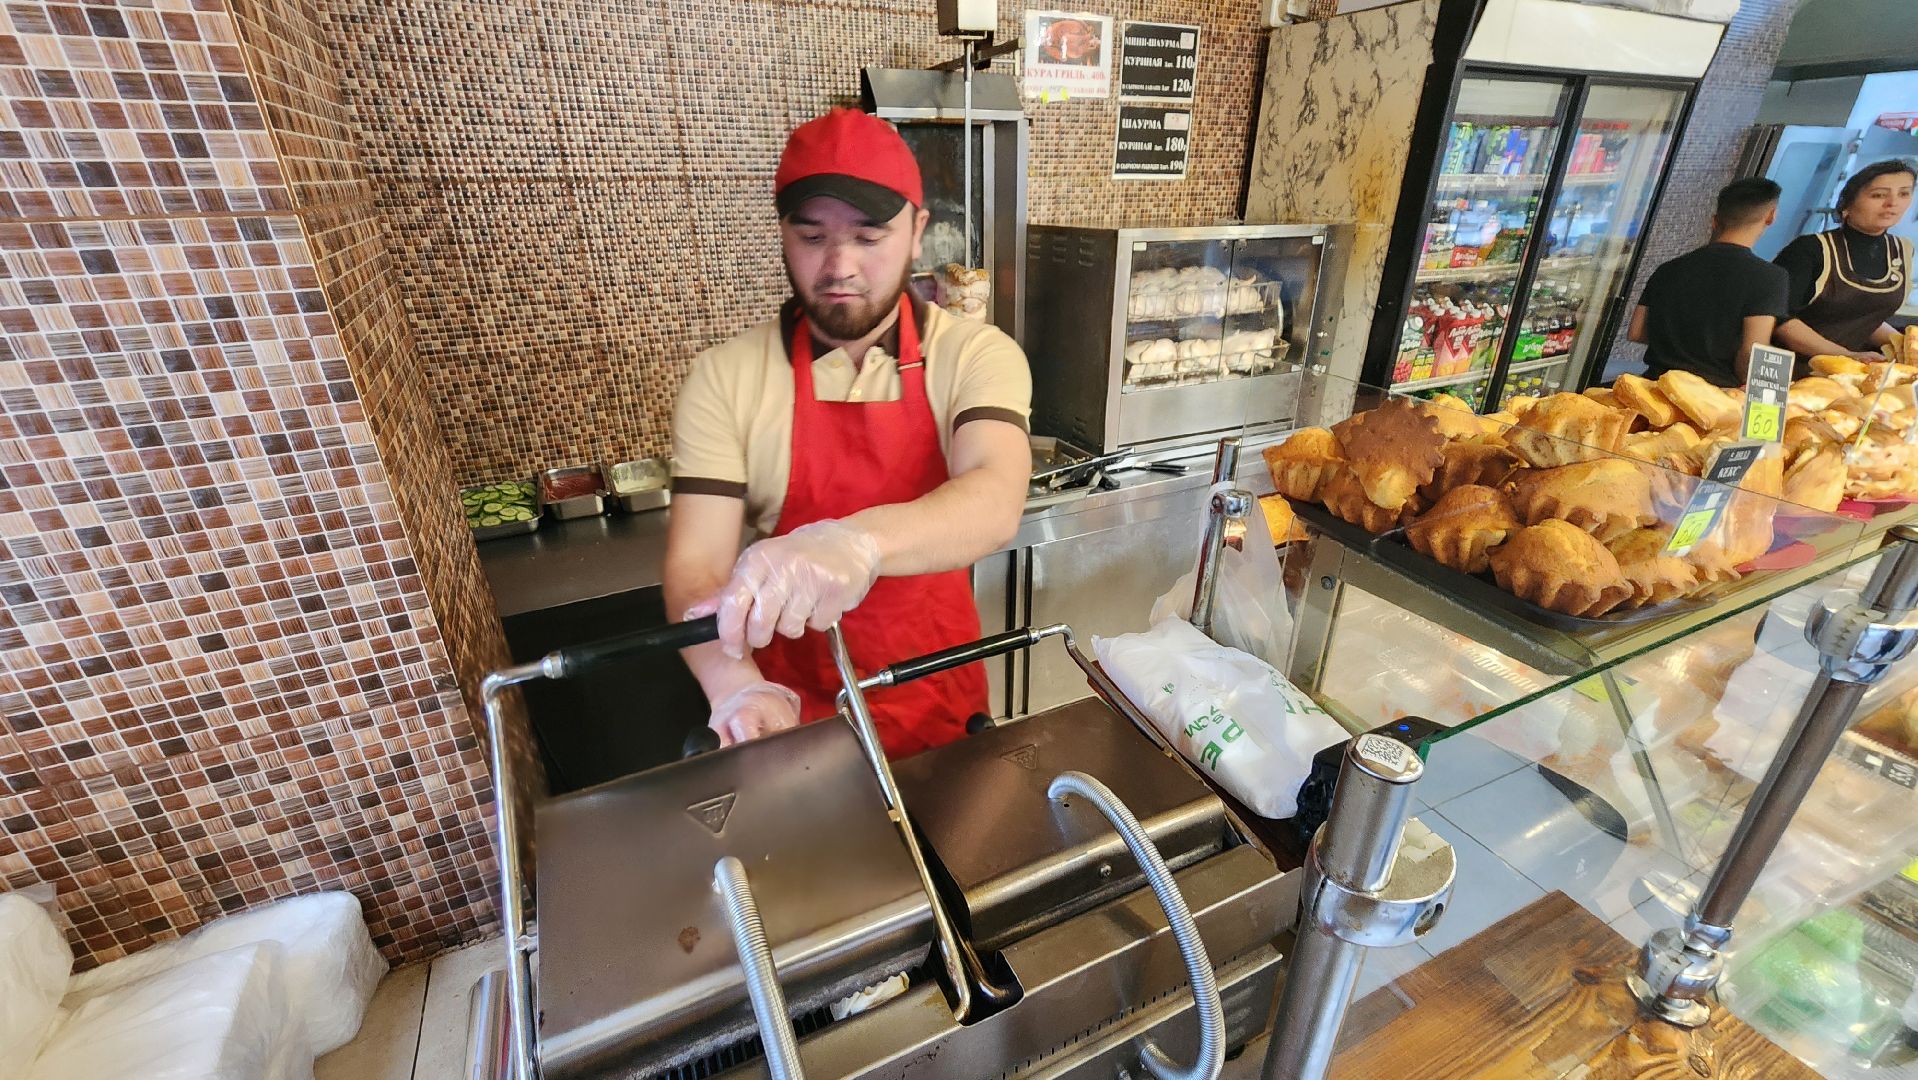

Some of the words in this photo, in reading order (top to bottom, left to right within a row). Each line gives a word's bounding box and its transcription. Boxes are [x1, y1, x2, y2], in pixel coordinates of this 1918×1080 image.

[1124, 56, 1162, 67] КУРИНАЯ
[1026, 66, 1052, 79] КУРА
[1121, 118, 1162, 130] ШАУРМА
[1118, 141, 1153, 151] КУРИНАЯ
[1717, 466, 1742, 479] КЕКС
